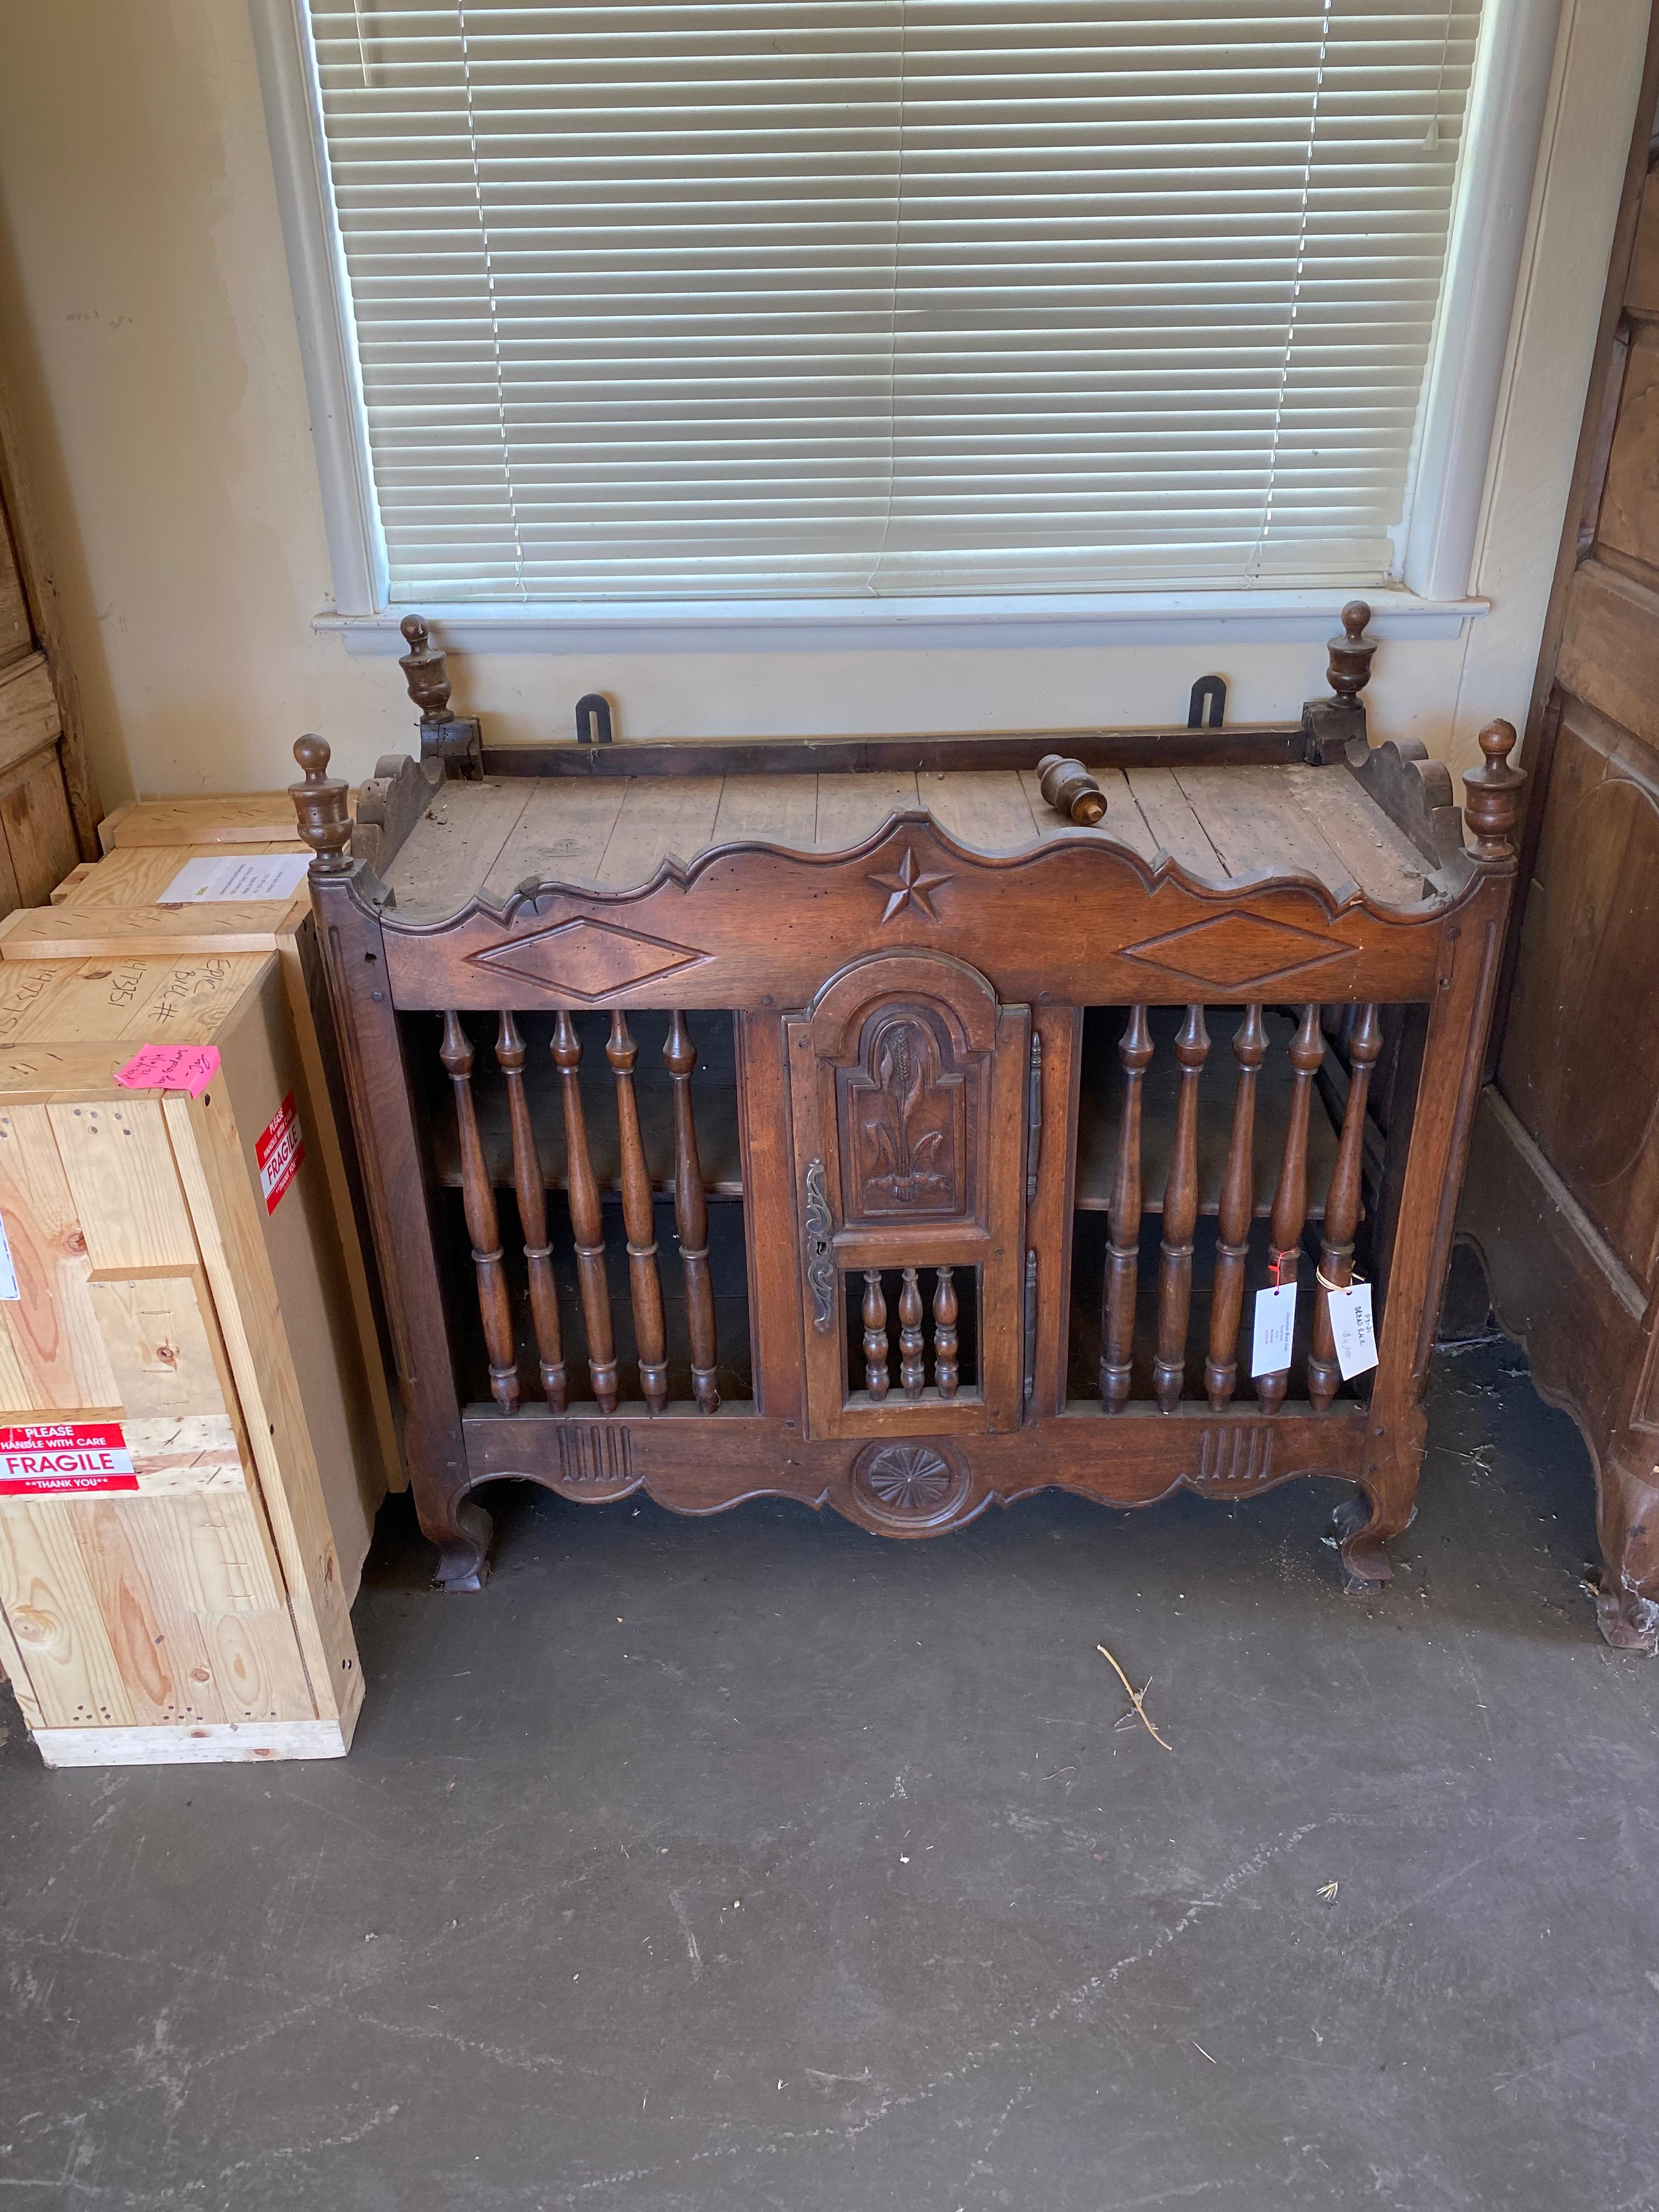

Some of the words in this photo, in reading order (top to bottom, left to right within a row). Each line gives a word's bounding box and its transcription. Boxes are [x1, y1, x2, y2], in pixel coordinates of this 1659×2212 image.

[269, 1107, 284, 1135] PLEASE
[263, 1134, 278, 1159] HANDLE
[267, 1124, 298, 1186] FRAGILE
[1, 1440, 45, 1450] HANDLE
[46, 1438, 74, 1448] WITH
[76, 1437, 107, 1446] CARE
[25, 1426, 74, 1438] PLEASE
[5, 1453, 115, 1475] FRAGILE
